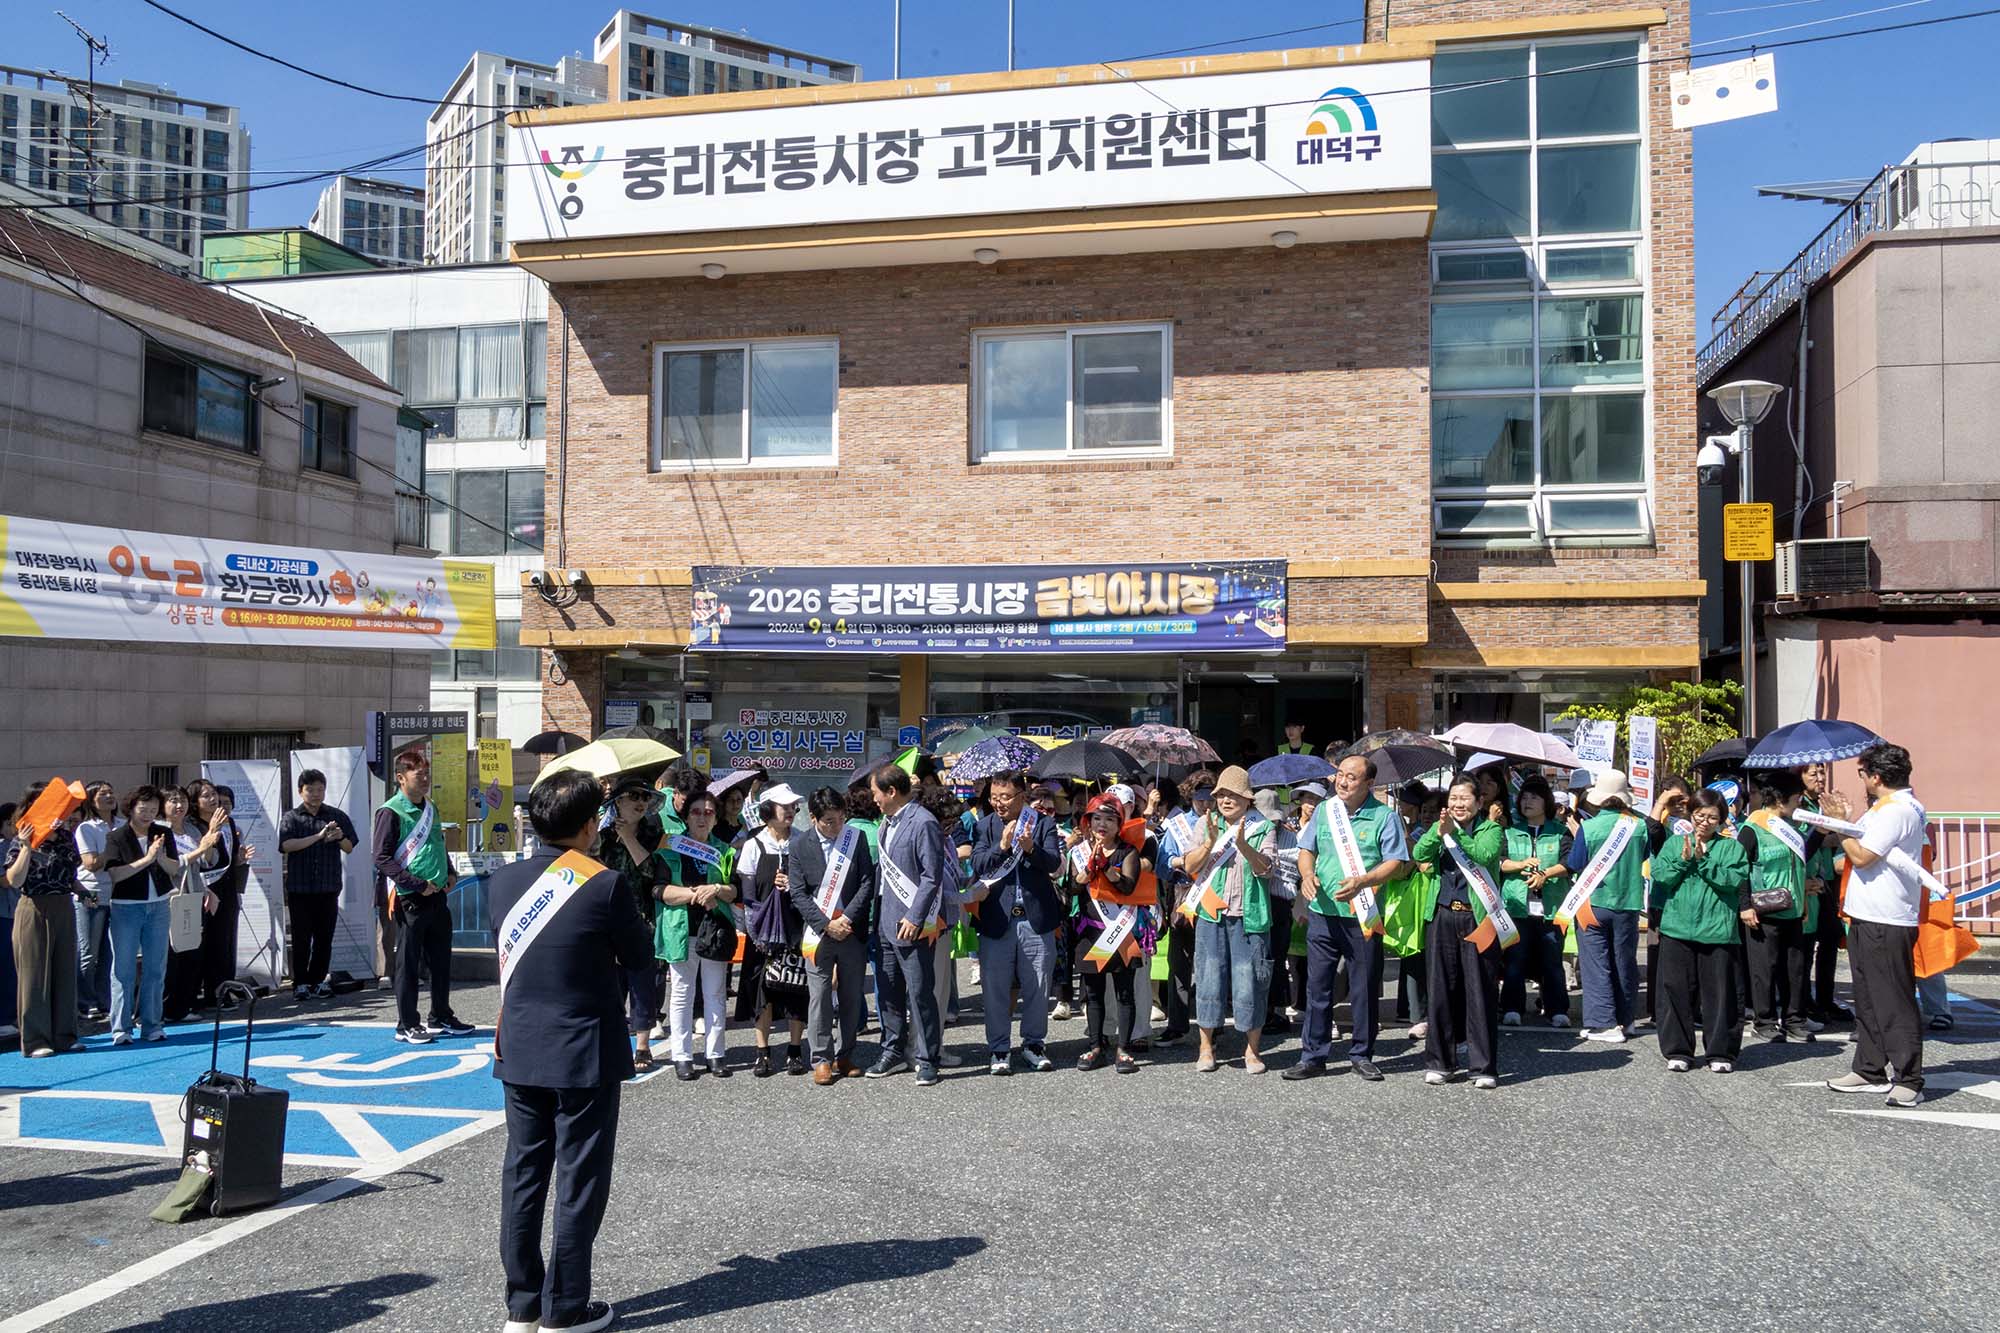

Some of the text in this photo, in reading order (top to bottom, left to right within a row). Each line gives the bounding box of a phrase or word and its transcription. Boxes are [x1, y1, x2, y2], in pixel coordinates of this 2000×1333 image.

[623, 108, 1266, 200] 중리전통시장 고객지원센터
[1297, 138, 1381, 165] 대덕구
[16, 551, 97, 573] 대전광역시
[237, 557, 309, 574] 국내산 가공식품
[18, 573, 97, 593] 중리전통시장
[219, 573, 330, 606] 환급행사
[749, 572, 1215, 616] 2026 중리전통시장 금빛야시장
[167, 603, 214, 625] 상품권
[768, 623, 805, 633] 2026년
[808, 618, 832, 634] 9월
[882, 624, 911, 634] 18:00
[922, 624, 951, 634] 21:00
[954, 624, 1014, 634] 중리전통시장
[1018, 624, 1038, 634] 일원
[390, 716, 465, 728] 중리전통시장 상점 안내도
[769, 711, 846, 725] 중리전통시장
[904, 736, 918, 745] 26
[731, 757, 785, 769] 623-1040
[800, 758, 854, 769] 634-4982
[838, 828, 853, 857] 소비자의
[1610, 826, 1627, 849] 소비자의
[516, 886, 557, 931] 소비자의
[507, 927, 522, 943] 힘
[1106, 925, 1122, 944] 입니다
